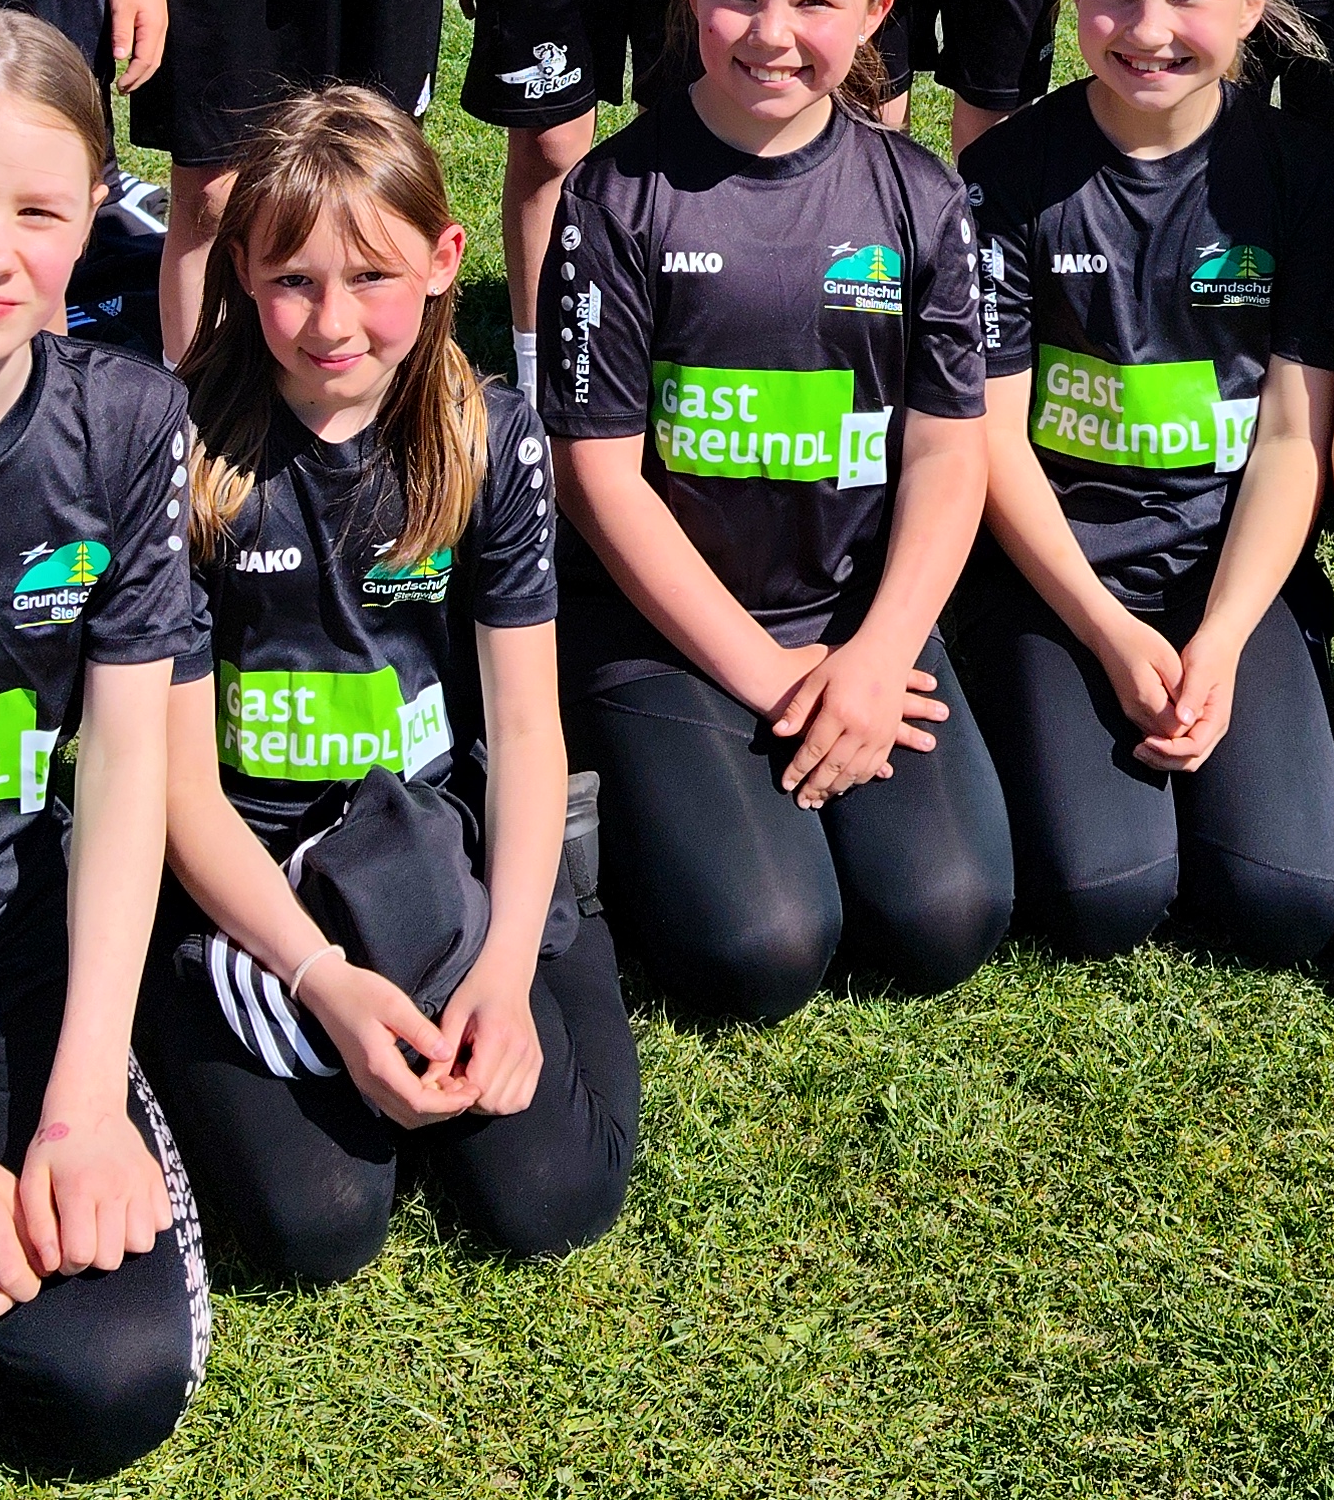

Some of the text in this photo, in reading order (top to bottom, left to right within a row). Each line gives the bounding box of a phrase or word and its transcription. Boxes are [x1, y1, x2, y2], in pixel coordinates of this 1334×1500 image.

[661, 252, 723, 274] JAKO
[1051, 254, 1107, 274] JAKO
[979, 248, 1002, 349] FLYERALARM
[575, 292, 590, 403] FLYERALARM
[662, 378, 759, 423] Gast
[1047, 363, 1124, 413] Gast
[236, 546, 302, 573] JAKO
[226, 682, 315, 724] Gast
